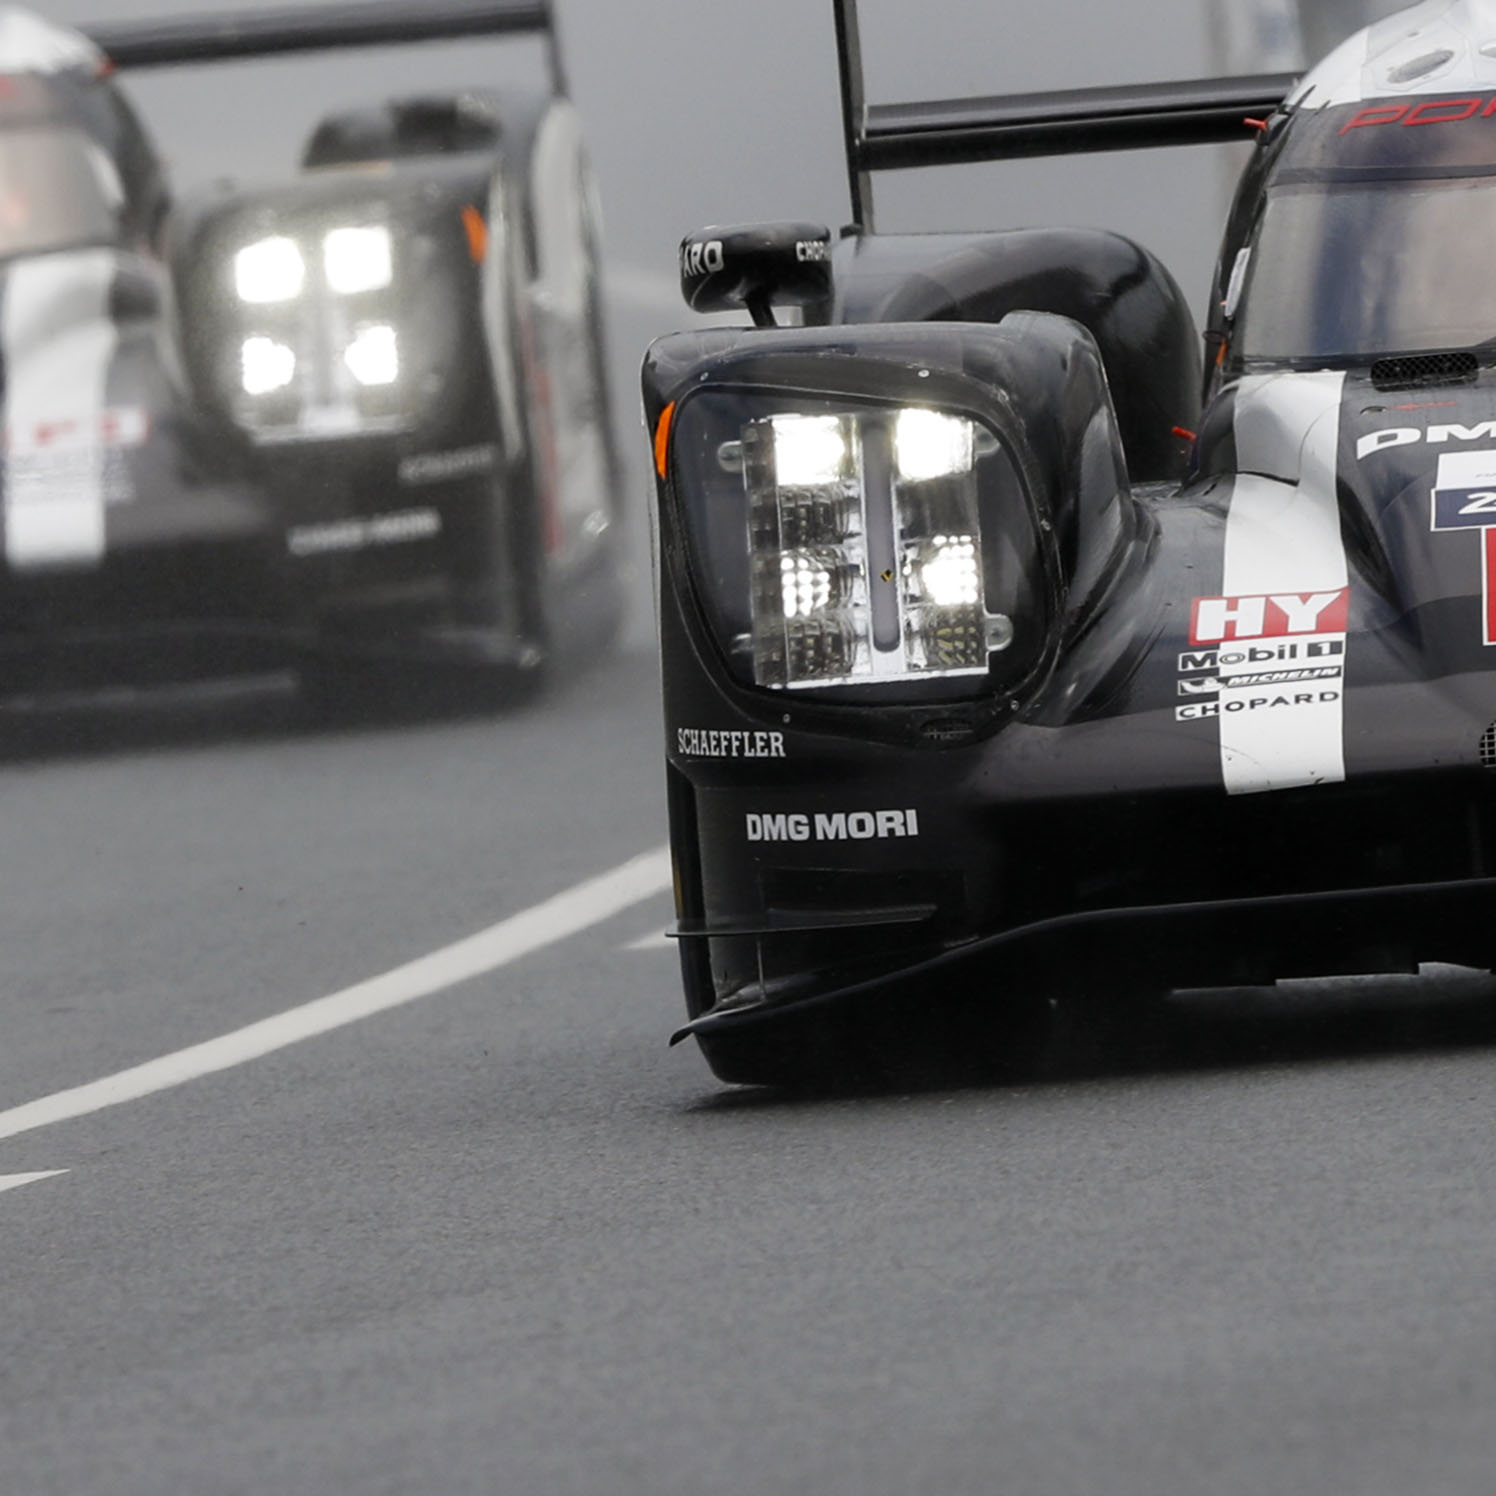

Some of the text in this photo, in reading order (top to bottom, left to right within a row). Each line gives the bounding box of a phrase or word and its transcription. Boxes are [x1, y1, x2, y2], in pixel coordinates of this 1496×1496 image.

[1195, 590, 1343, 641] HY
[1180, 642, 1298, 670] Mobil
[1226, 666, 1340, 687] MICHELIN
[1178, 690, 1340, 719] CHOPARD
[677, 727, 787, 758] SCHAEFFLER
[745, 808, 920, 842] DMG MORI
